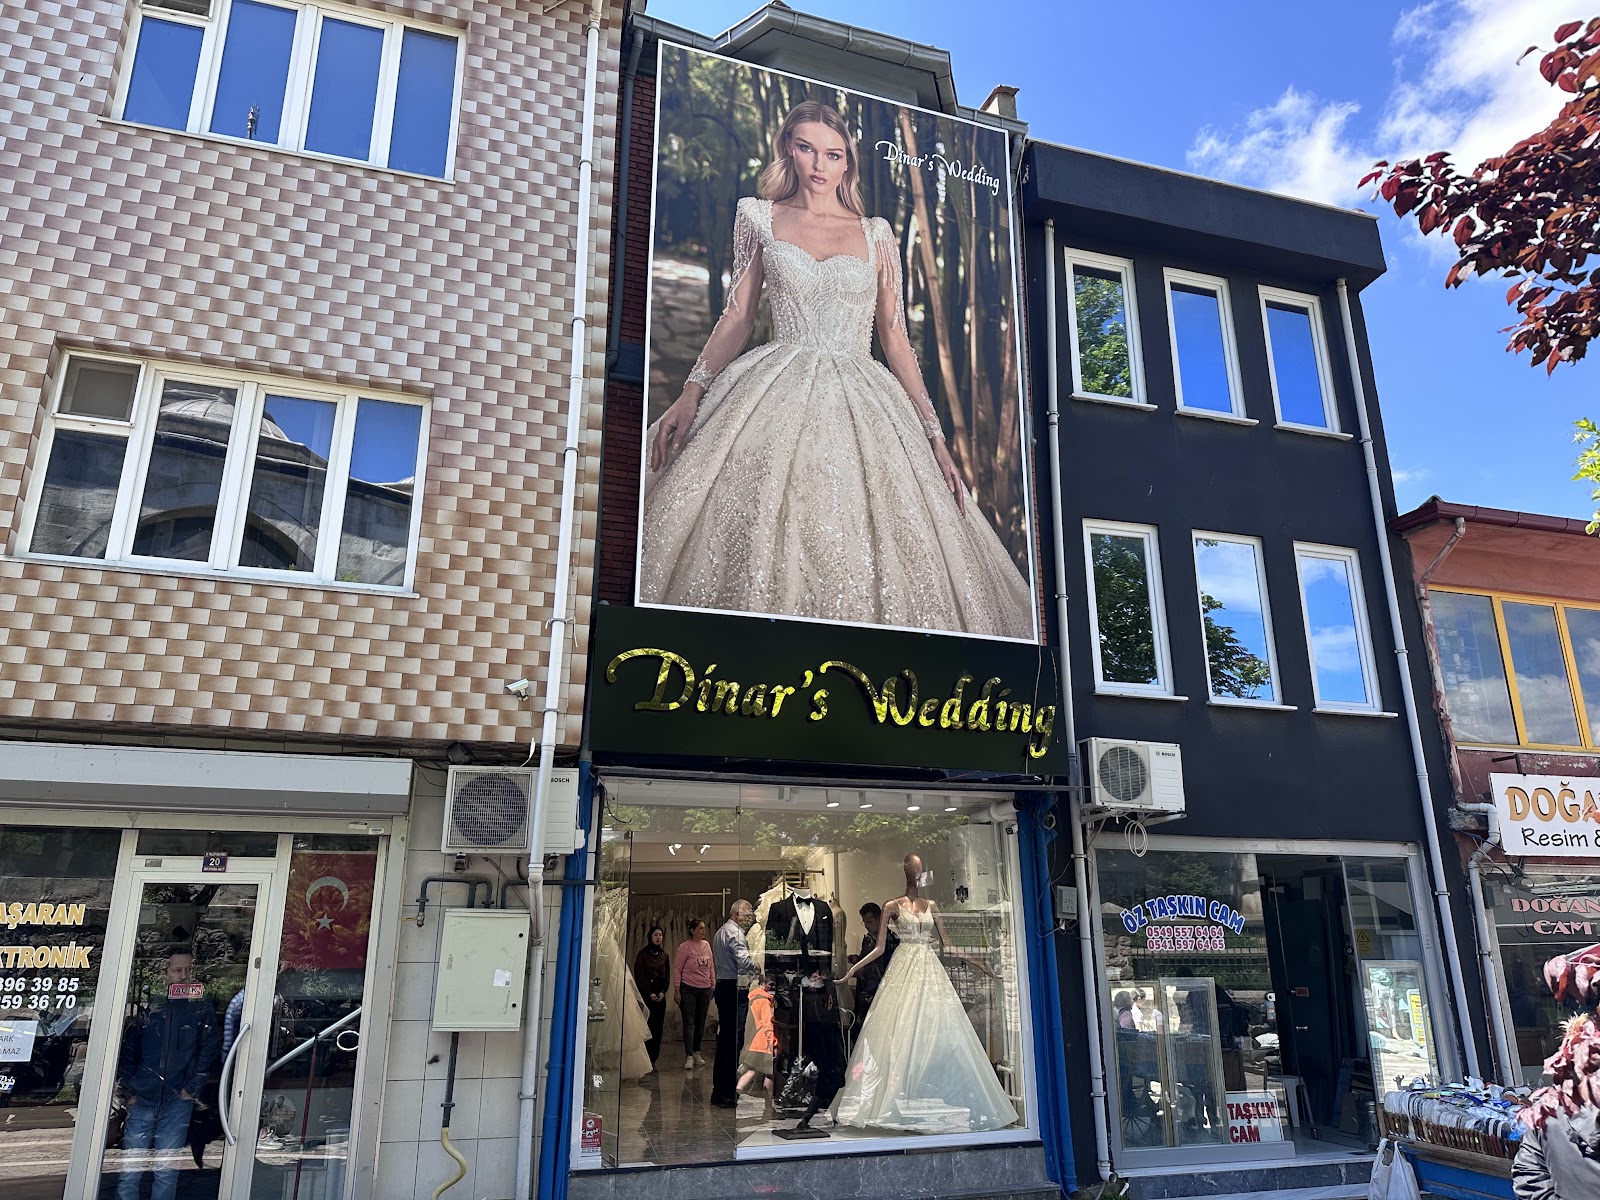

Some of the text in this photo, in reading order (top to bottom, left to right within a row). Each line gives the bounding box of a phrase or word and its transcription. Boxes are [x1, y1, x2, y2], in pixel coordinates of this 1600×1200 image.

[875, 140, 1000, 196] Dinar's Wedding
[606, 647, 1056, 759] Dinar's Wedding
[1504, 781, 1600, 823] DOĞA
[1521, 827, 1589, 847] Resim
[209, 857, 221, 866] 20
[1510, 895, 1600, 913] DOĞAN
[1120, 895, 1245, 935] ÖZ TAŞKIN CAM
[1146, 926, 1224, 938] 0549 557 64 64
[1533, 919, 1592, 935] CAM
[1147, 939, 1225, 951] 0541 597 64 65
[30, 977, 53, 992] 39
[57, 977, 79, 992] 85
[0, 994, 76, 1010] 59 36 70
[1227, 1101, 1276, 1124] TAŞKIN
[1230, 1125, 1261, 1143] CAM
